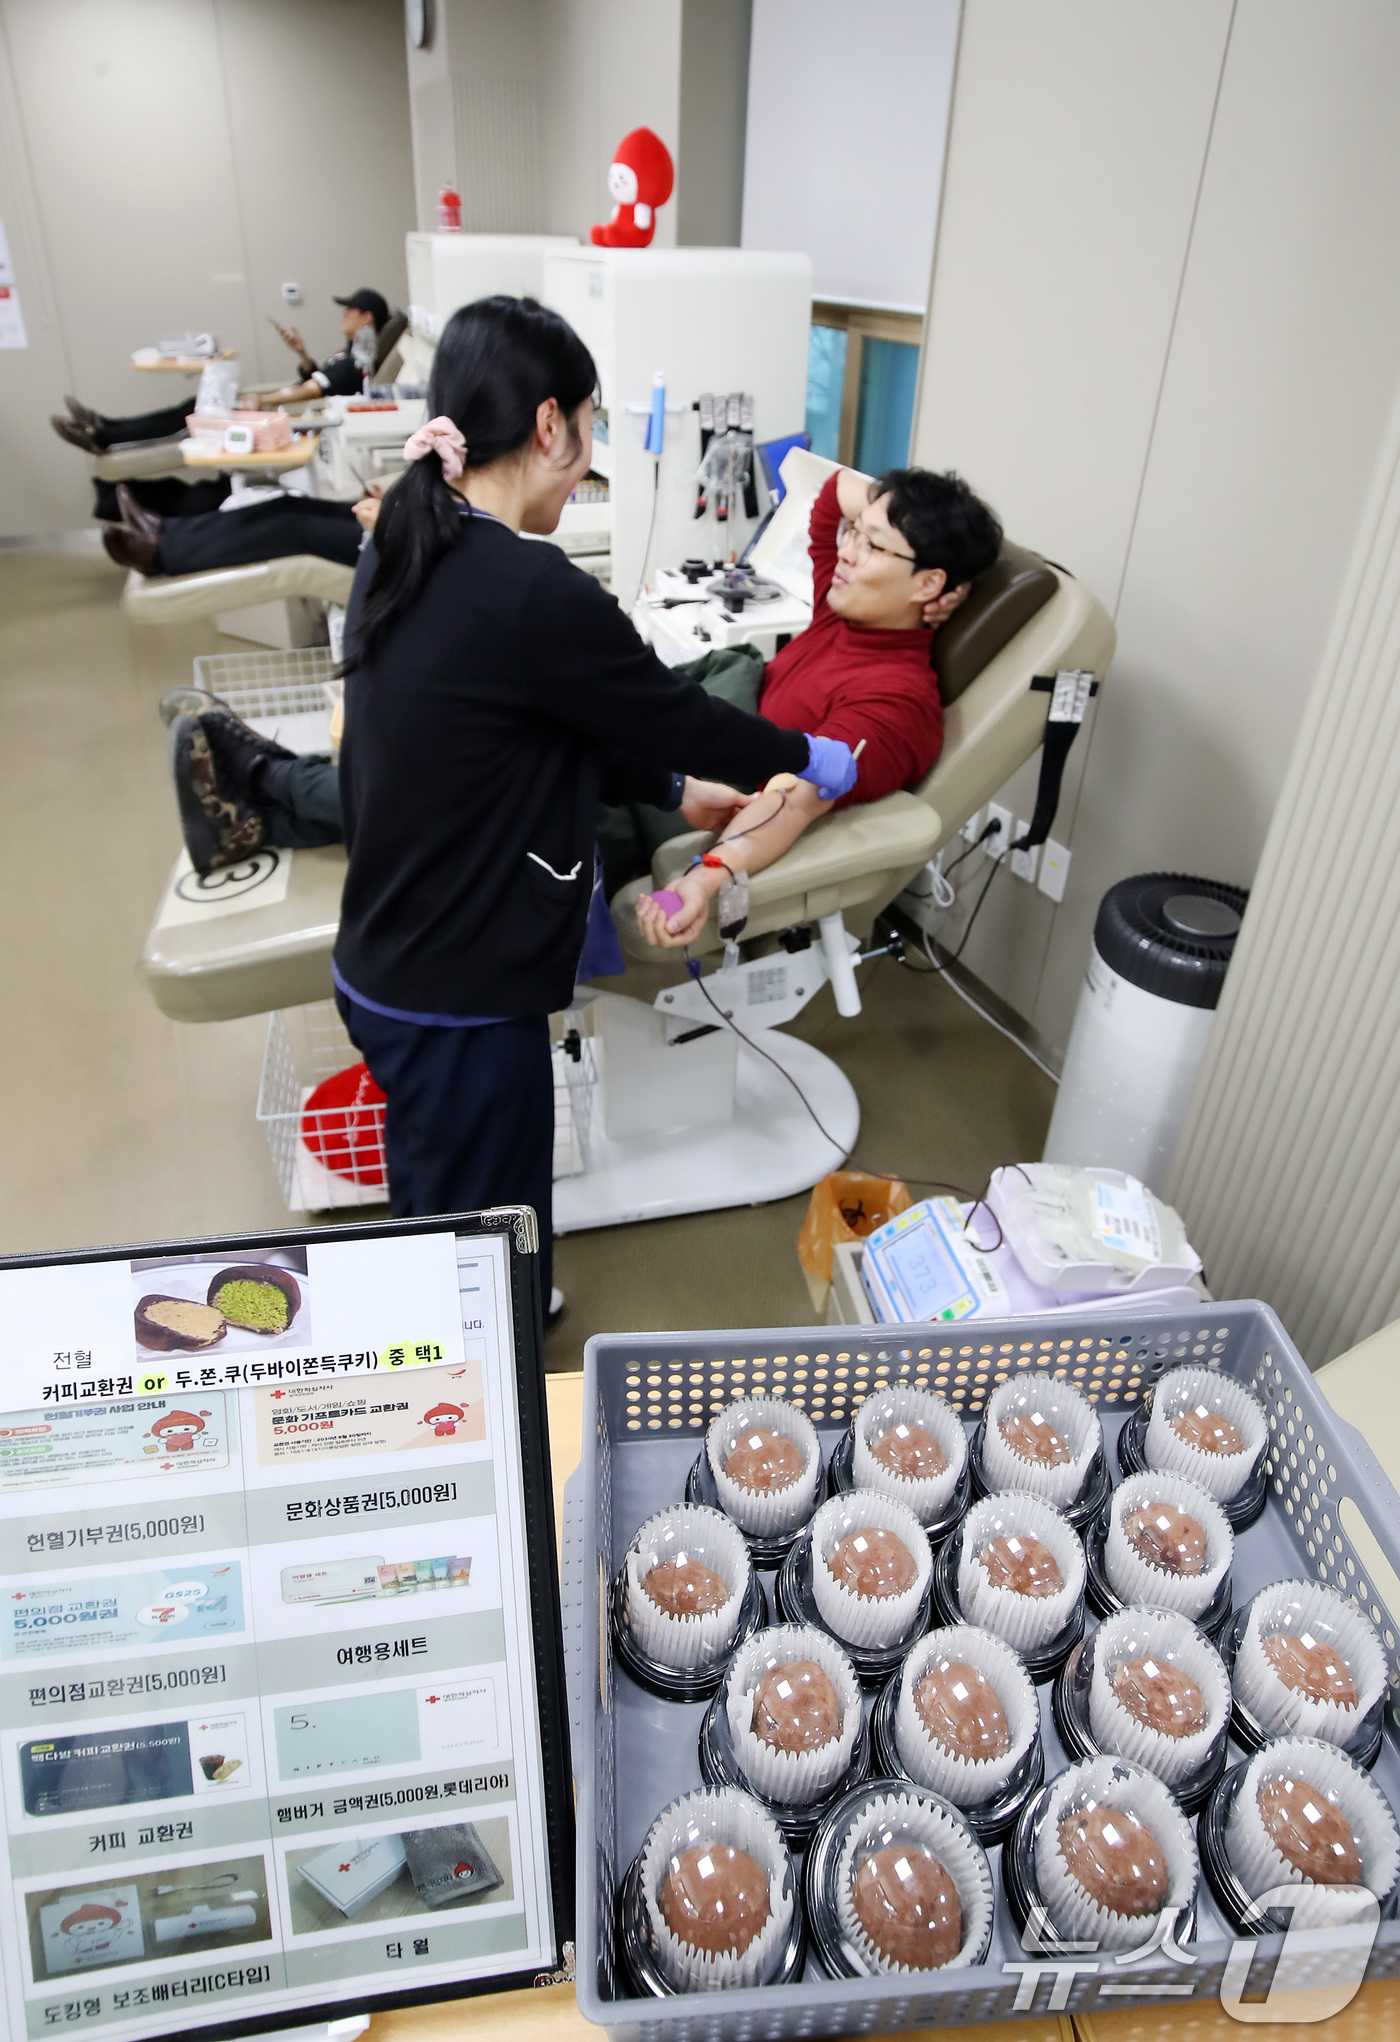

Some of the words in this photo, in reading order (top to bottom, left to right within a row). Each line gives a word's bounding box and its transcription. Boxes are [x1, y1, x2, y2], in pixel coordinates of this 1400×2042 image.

[53, 1350, 92, 1370] 전혈
[42, 1375, 133, 1402] 커피교환권
[144, 1376, 165, 1391] or
[175, 1350, 378, 1389] 두.쫀.쿠(두바이쫀득쿠키)
[389, 1348, 405, 1366] 중
[415, 1345, 443, 1363] 택1
[44, 1406, 107, 1422] 헌혈기부권
[109, 1403, 135, 1414] 사업
[137, 1400, 166, 1411] 안내
[272, 1413, 298, 1426] 문화
[302, 1407, 367, 1421] 기프트카드
[369, 1401, 409, 1414] 교환권
[273, 1420, 334, 1435] 5,000원
[286, 1483, 457, 1522] 문화상품권[5,000원]
[165, 1588, 201, 1599] GS25
[13, 1604, 63, 1618] 편의점
[68, 1598, 117, 1611] 교환권
[14, 1608, 119, 1629] 5,000원권
[337, 1636, 428, 1664] 여행용세트
[28, 1665, 226, 1707] 편의점교환권[5,000원]
[73, 1747, 99, 1757] 커피
[277, 1801, 324, 1823] 햄버거
[89, 1831, 126, 1853] 커피
[138, 1821, 193, 1845] 교환권
[386, 1941, 403, 1959] 타
[44, 1996, 101, 2025] 도킹형
[113, 1965, 270, 2011] 보조배터리[C타입]
